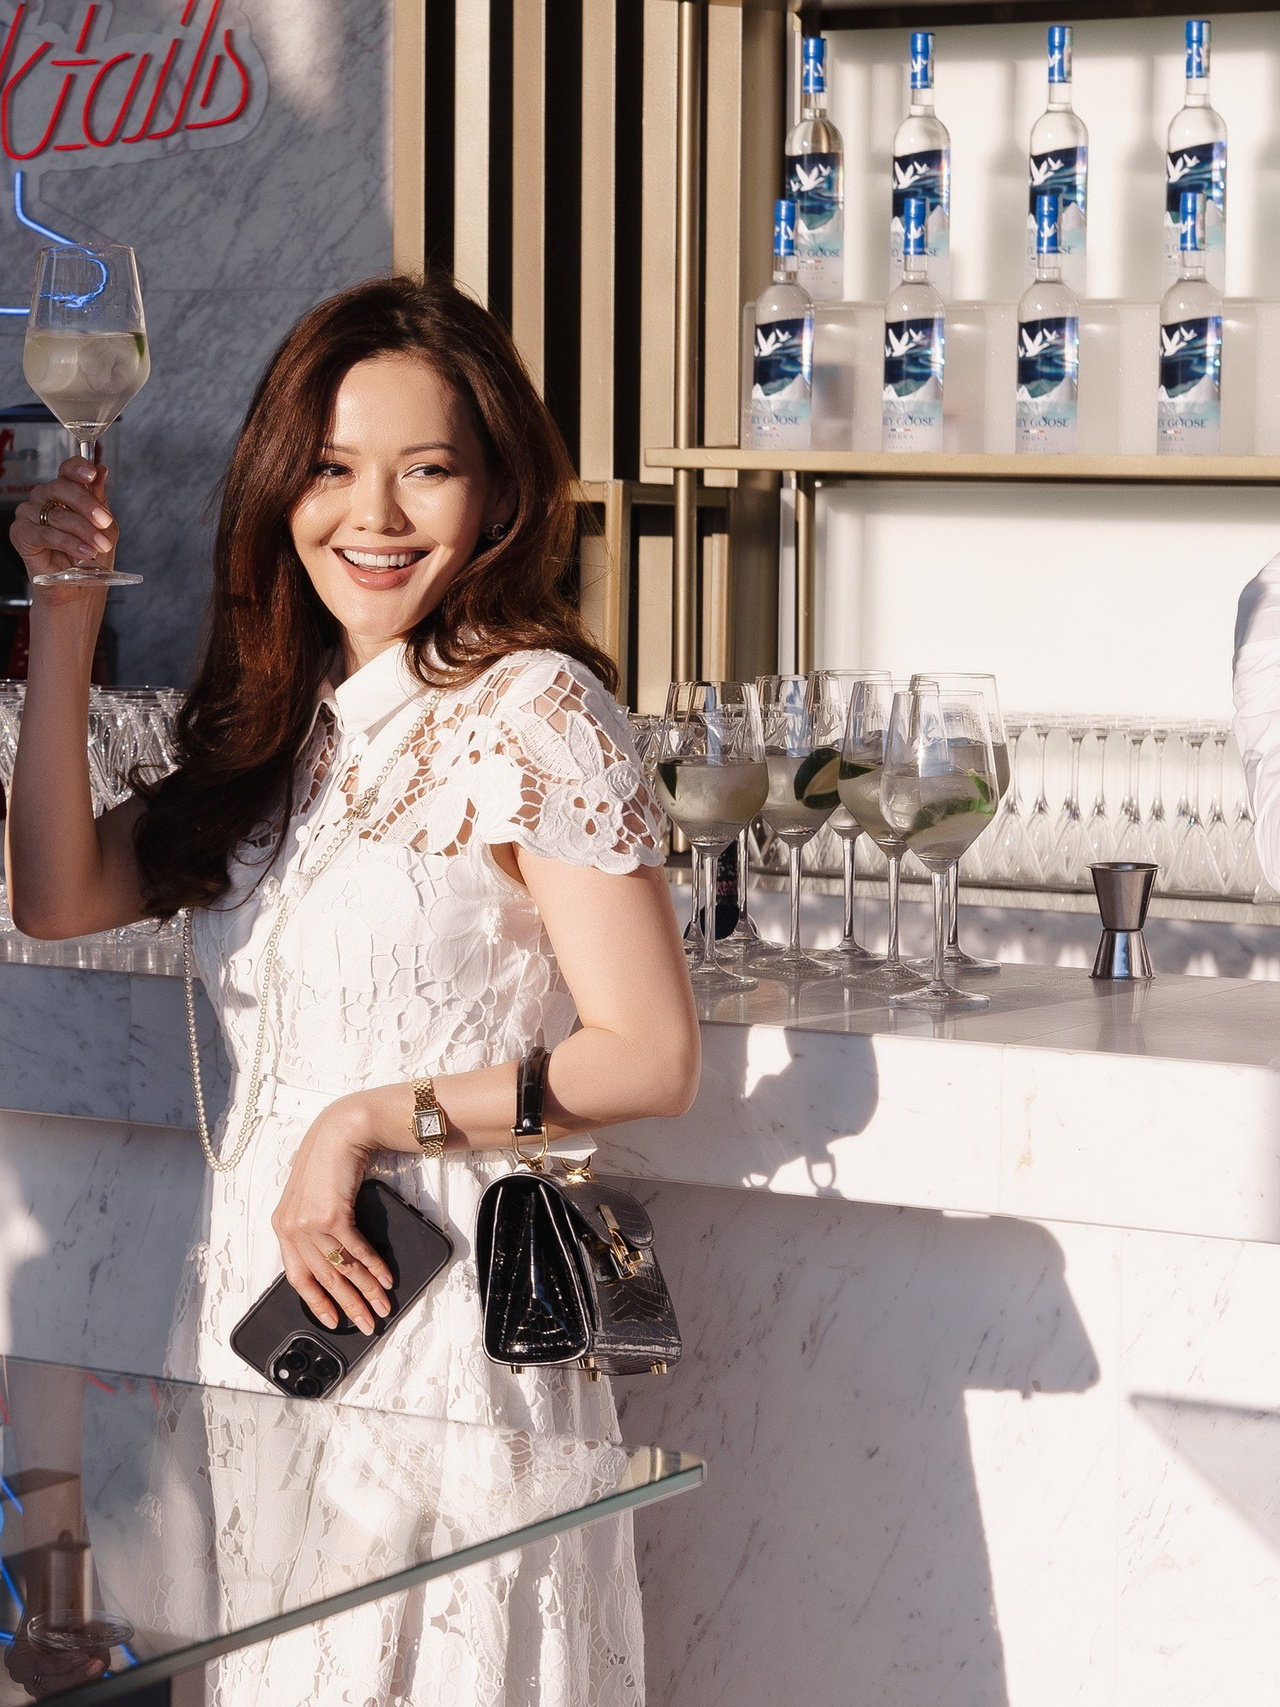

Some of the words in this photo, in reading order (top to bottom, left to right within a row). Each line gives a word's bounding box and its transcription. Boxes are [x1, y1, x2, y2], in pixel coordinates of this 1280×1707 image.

[763, 413, 800, 426] GOOSE
[897, 414, 935, 427] GOOSE
[1030, 415, 1069, 428] GOOSE
[1168, 416, 1207, 429] GOOSE
